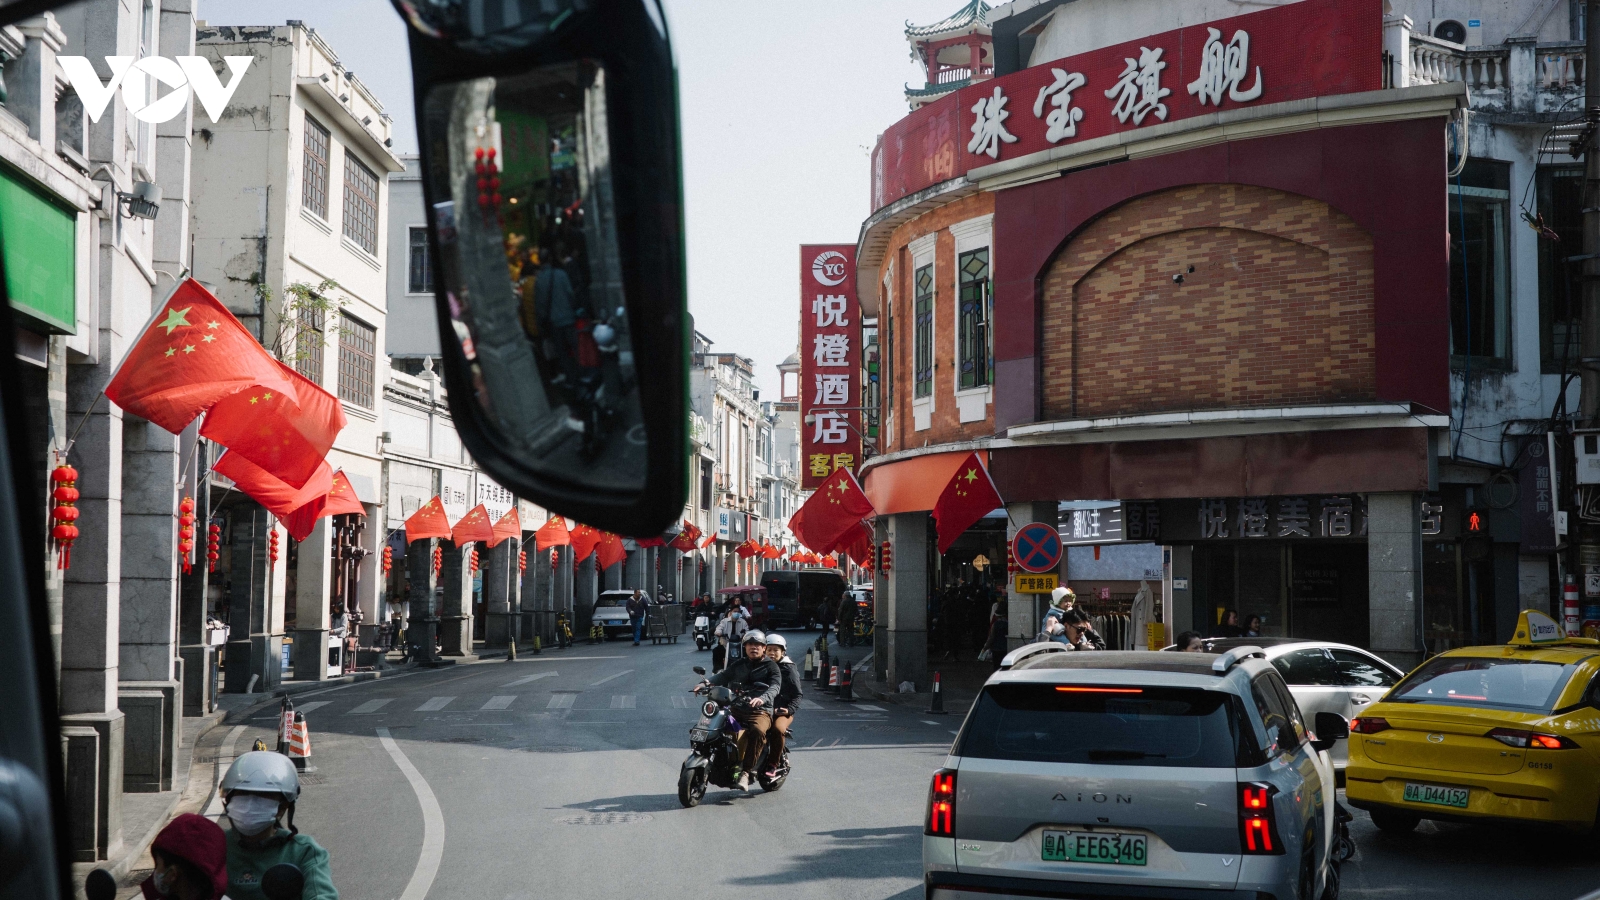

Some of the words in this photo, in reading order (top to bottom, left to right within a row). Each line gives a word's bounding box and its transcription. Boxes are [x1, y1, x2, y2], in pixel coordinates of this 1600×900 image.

[967, 27, 1262, 159] 珠宝旗舰
[812, 294, 850, 444] 悦橙酒店
[1536, 466, 1549, 513] 和而不同
[1019, 577, 1054, 590] 严管路段
[1528, 761, 1553, 770] G6158
